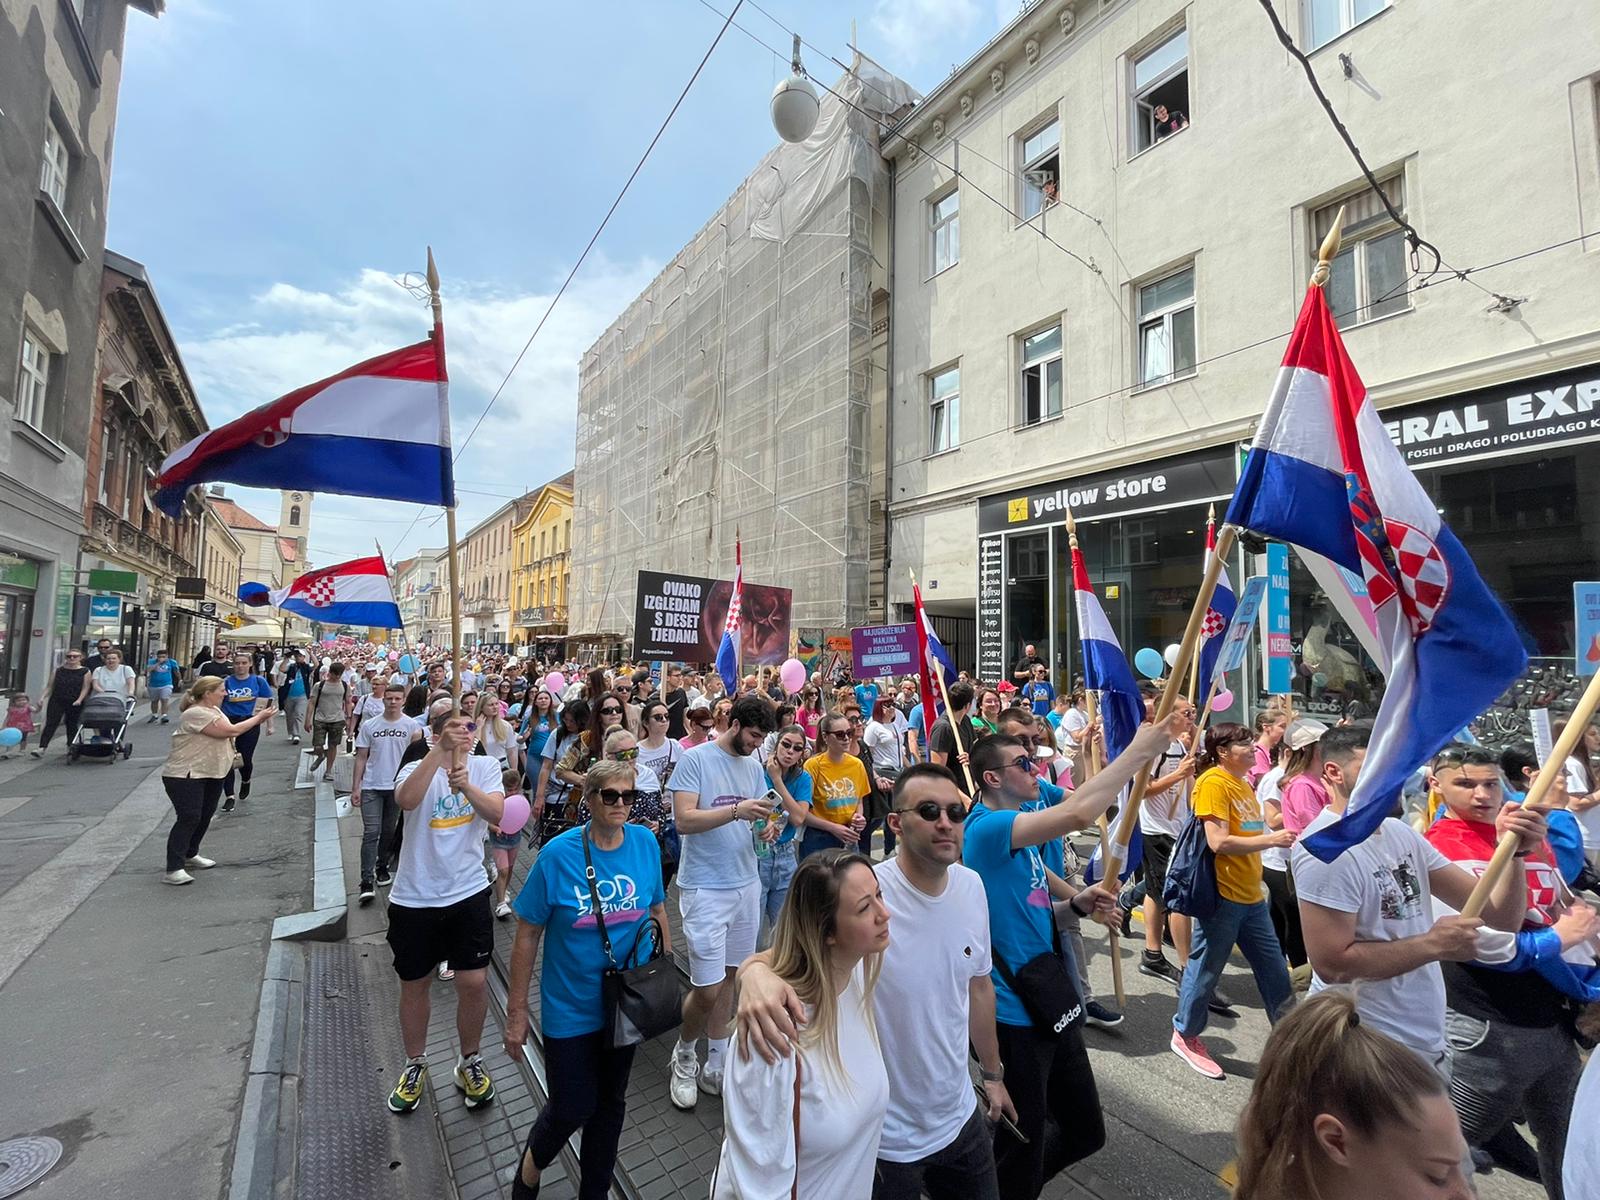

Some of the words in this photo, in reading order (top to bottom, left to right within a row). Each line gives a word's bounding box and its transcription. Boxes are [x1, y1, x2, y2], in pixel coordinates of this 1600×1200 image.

[1384, 405, 1489, 446] ERAL
[1507, 379, 1600, 425] EXP
[1407, 446, 1443, 460] FOSILI
[1447, 438, 1491, 453] DRAGO
[1501, 420, 1587, 444] POLUDRAGO
[1033, 488, 1099, 519] yellow
[1105, 475, 1167, 501] store
[663, 580, 702, 599] OVAKO
[643, 594, 701, 614] IZGLEDAM
[654, 611, 663, 627] S
[665, 612, 700, 629] DESET
[650, 627, 699, 644] TJEDANA
[372, 728, 407, 739] adidas
[1053, 1003, 1082, 1034] adidas
